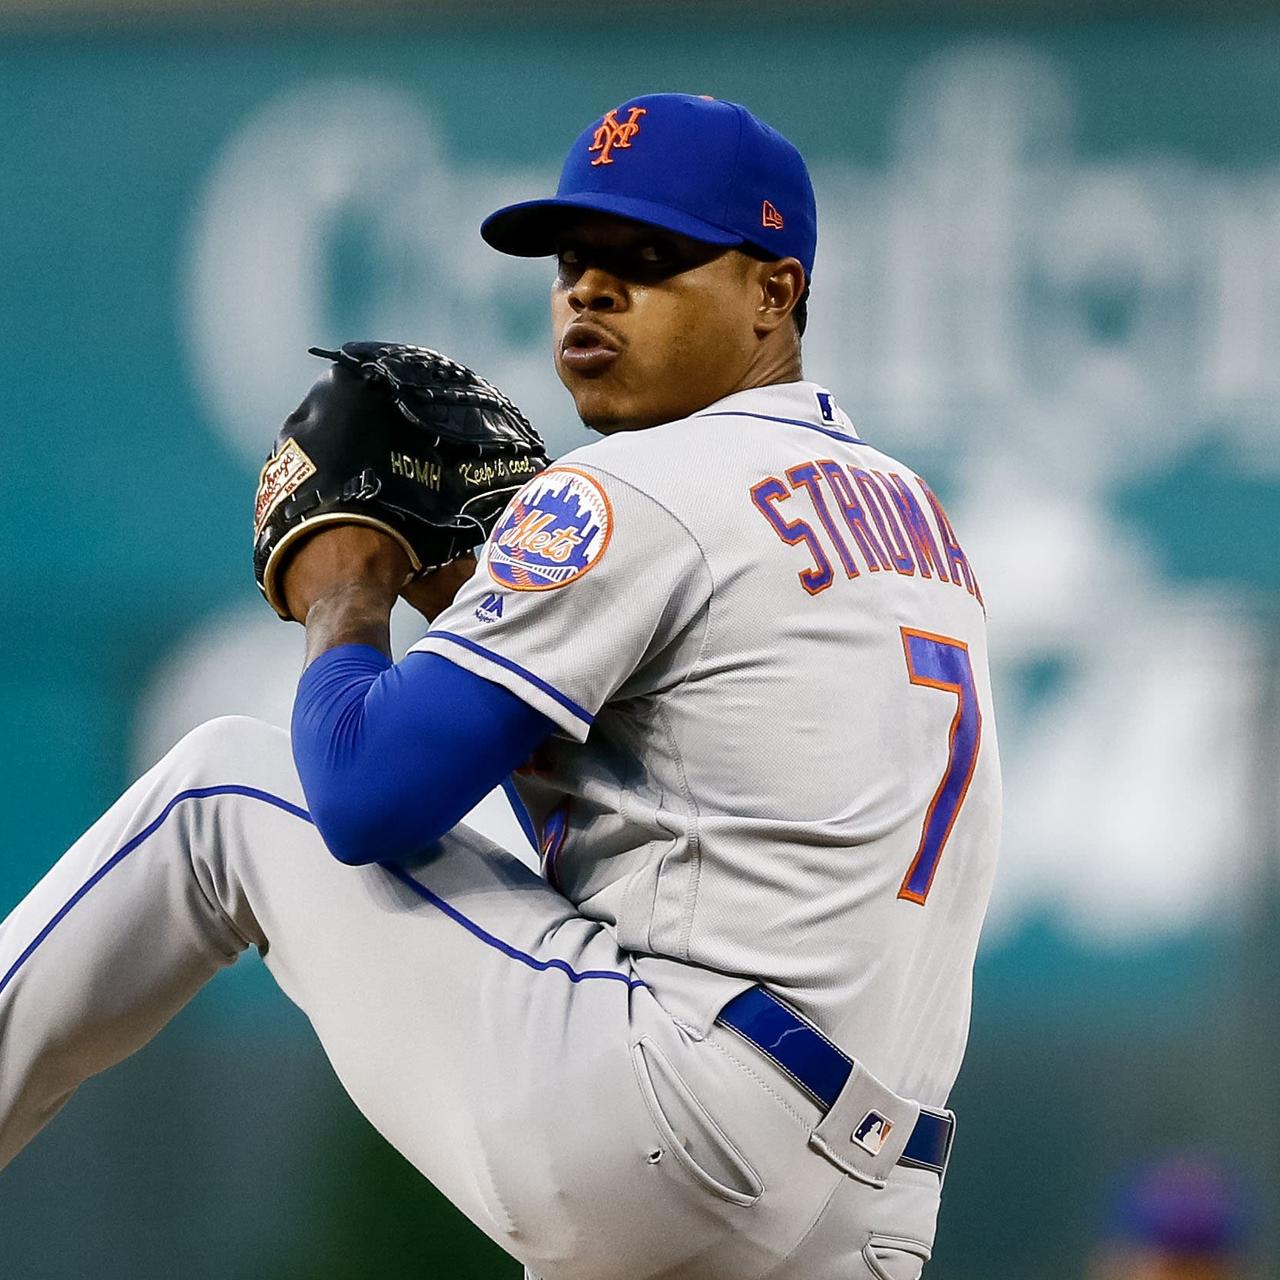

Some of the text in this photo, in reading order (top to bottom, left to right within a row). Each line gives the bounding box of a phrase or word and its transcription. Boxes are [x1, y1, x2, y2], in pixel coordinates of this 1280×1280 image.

[390, 450, 441, 492] HDMH
[459, 461, 495, 487] Keep
[493, 457, 506, 477] it
[498, 508, 582, 565] Mets
[750, 459, 985, 607] STROMA
[896, 625, 982, 907] 7
